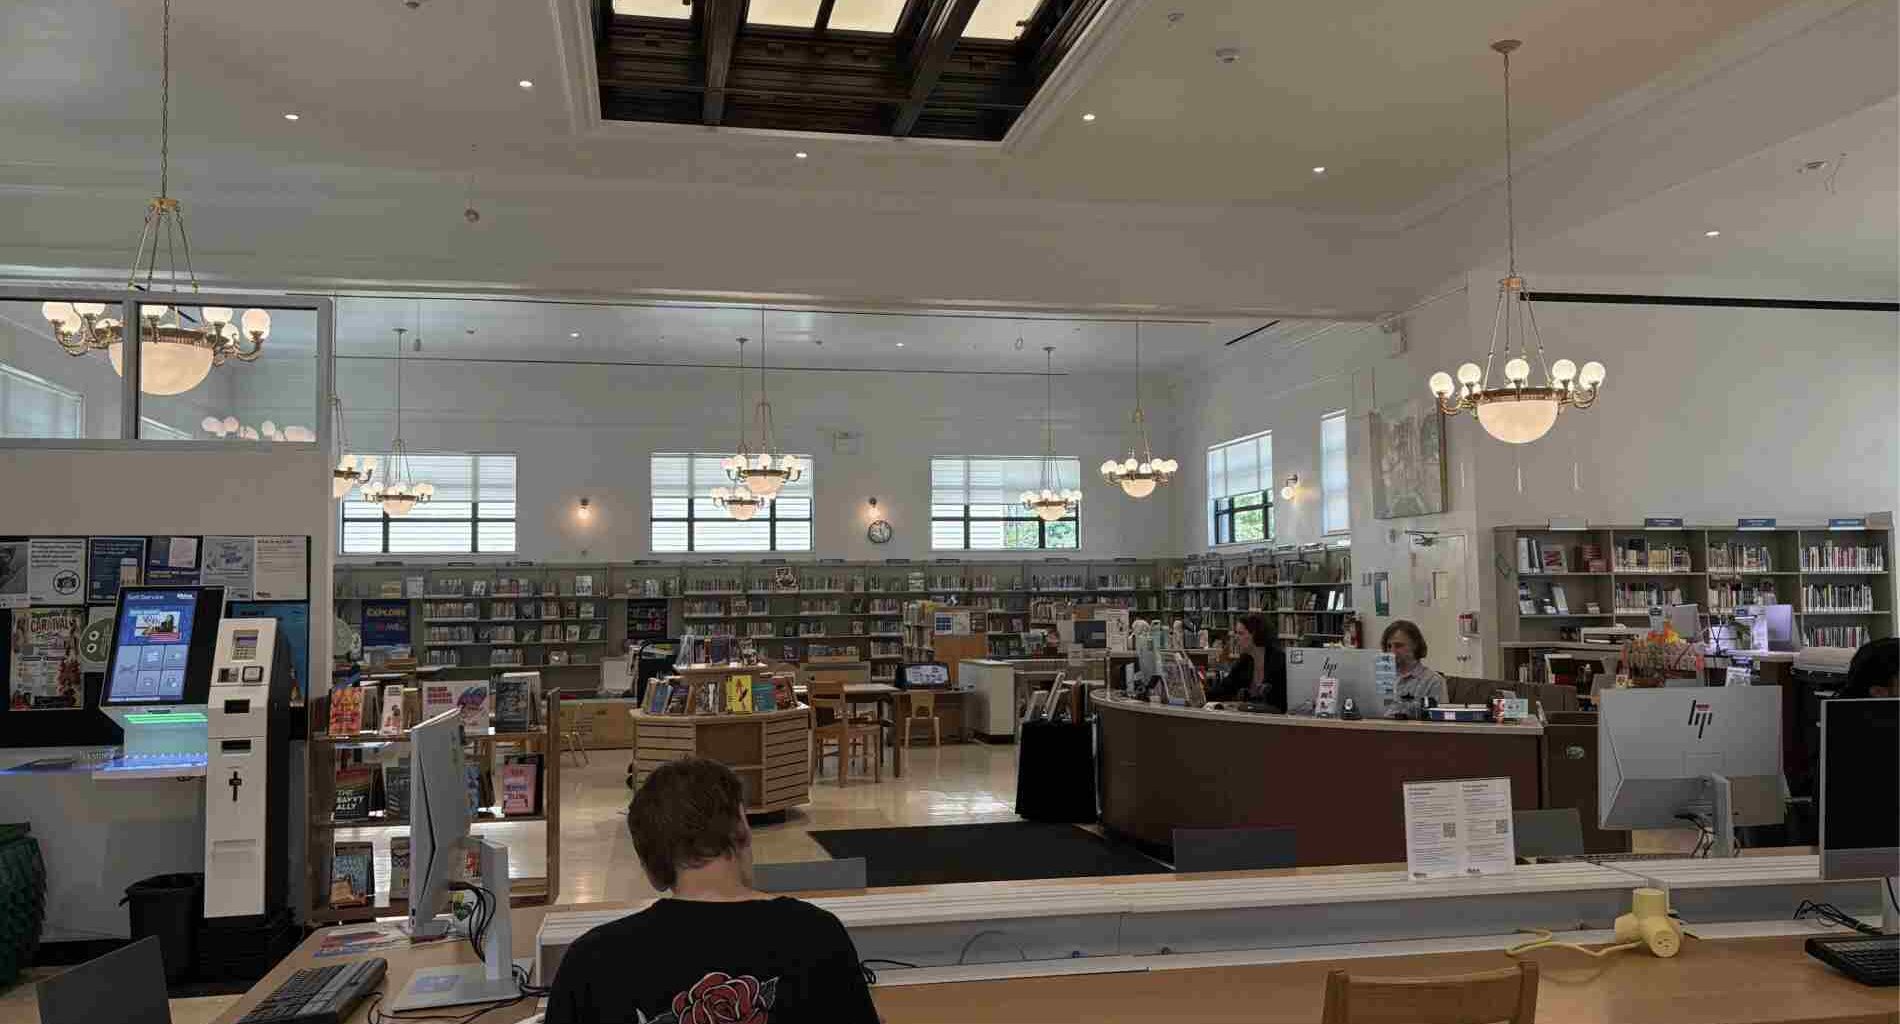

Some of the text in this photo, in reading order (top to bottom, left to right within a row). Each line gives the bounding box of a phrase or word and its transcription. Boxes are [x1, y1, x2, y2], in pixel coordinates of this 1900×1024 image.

[1322, 656, 1337, 678] hp
[1687, 699, 1713, 740] hp
[336, 795, 366, 804] SAVVY
[336, 801, 357, 810] ALLY
